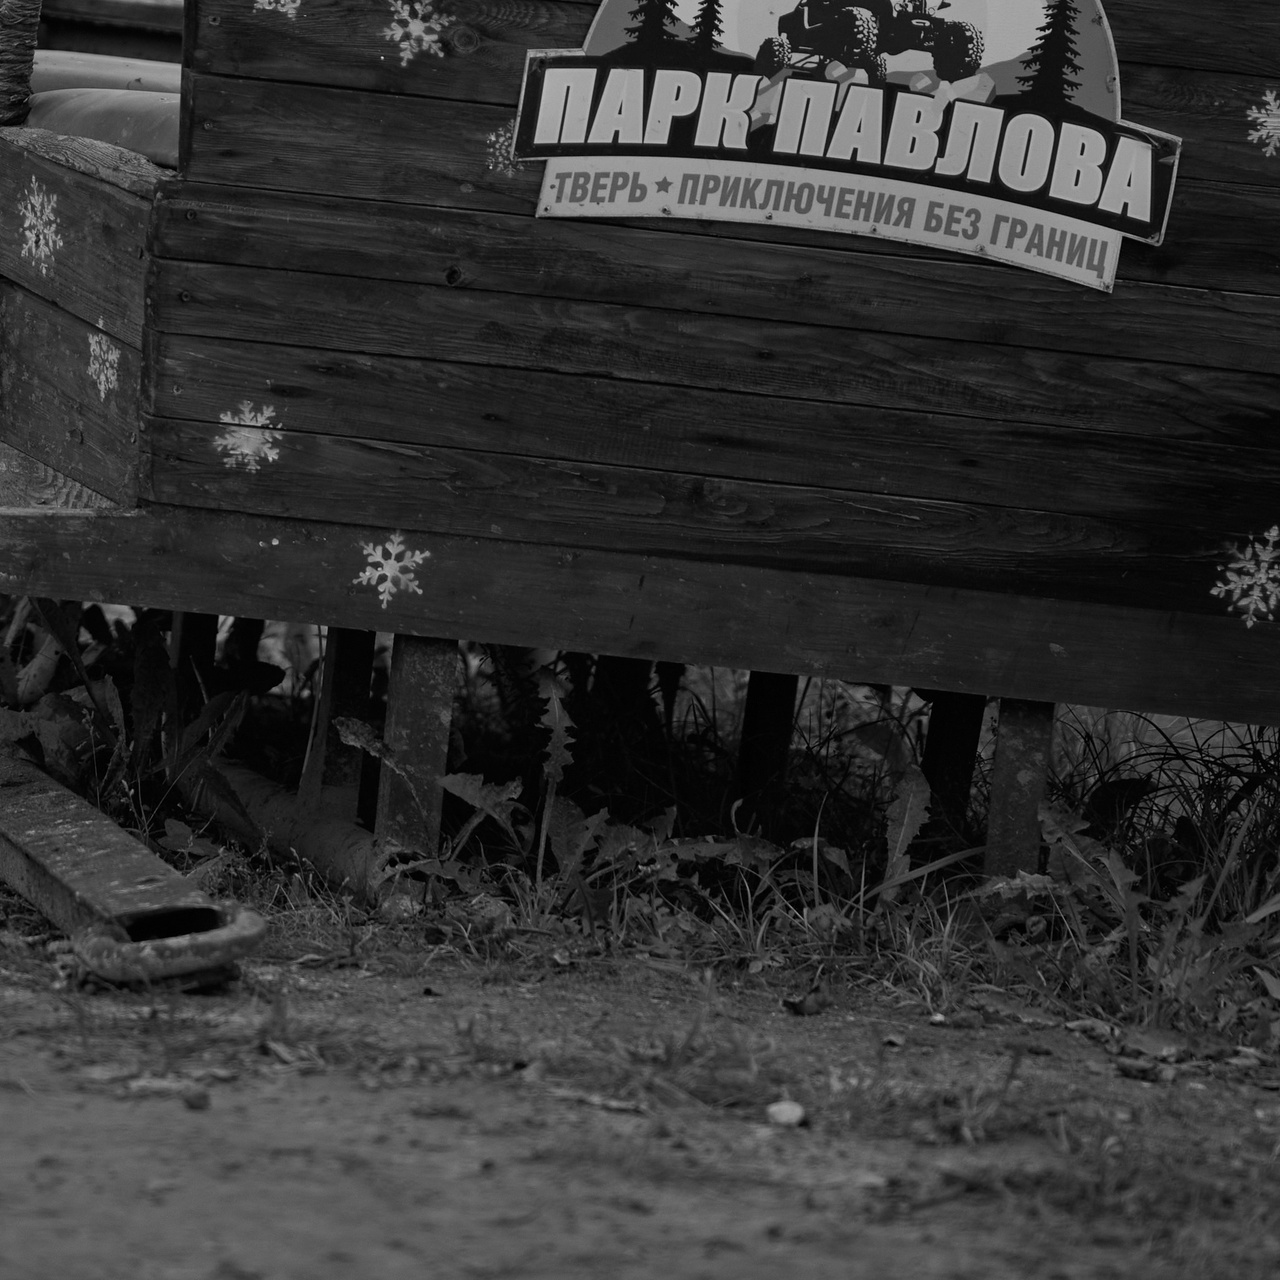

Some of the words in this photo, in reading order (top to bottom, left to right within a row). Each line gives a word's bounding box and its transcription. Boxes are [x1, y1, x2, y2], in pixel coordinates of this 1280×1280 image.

[533, 68, 764, 148] ПАРК
[772, 79, 1153, 223] ПАВЛОВА
[554, 172, 648, 204] ТВЕРЬ
[677, 173, 916, 230] ПРИКЛЮЧЕНИЯ
[924, 202, 981, 241] БЕЗ
[989, 215, 1108, 280] ГРАНИЦ
